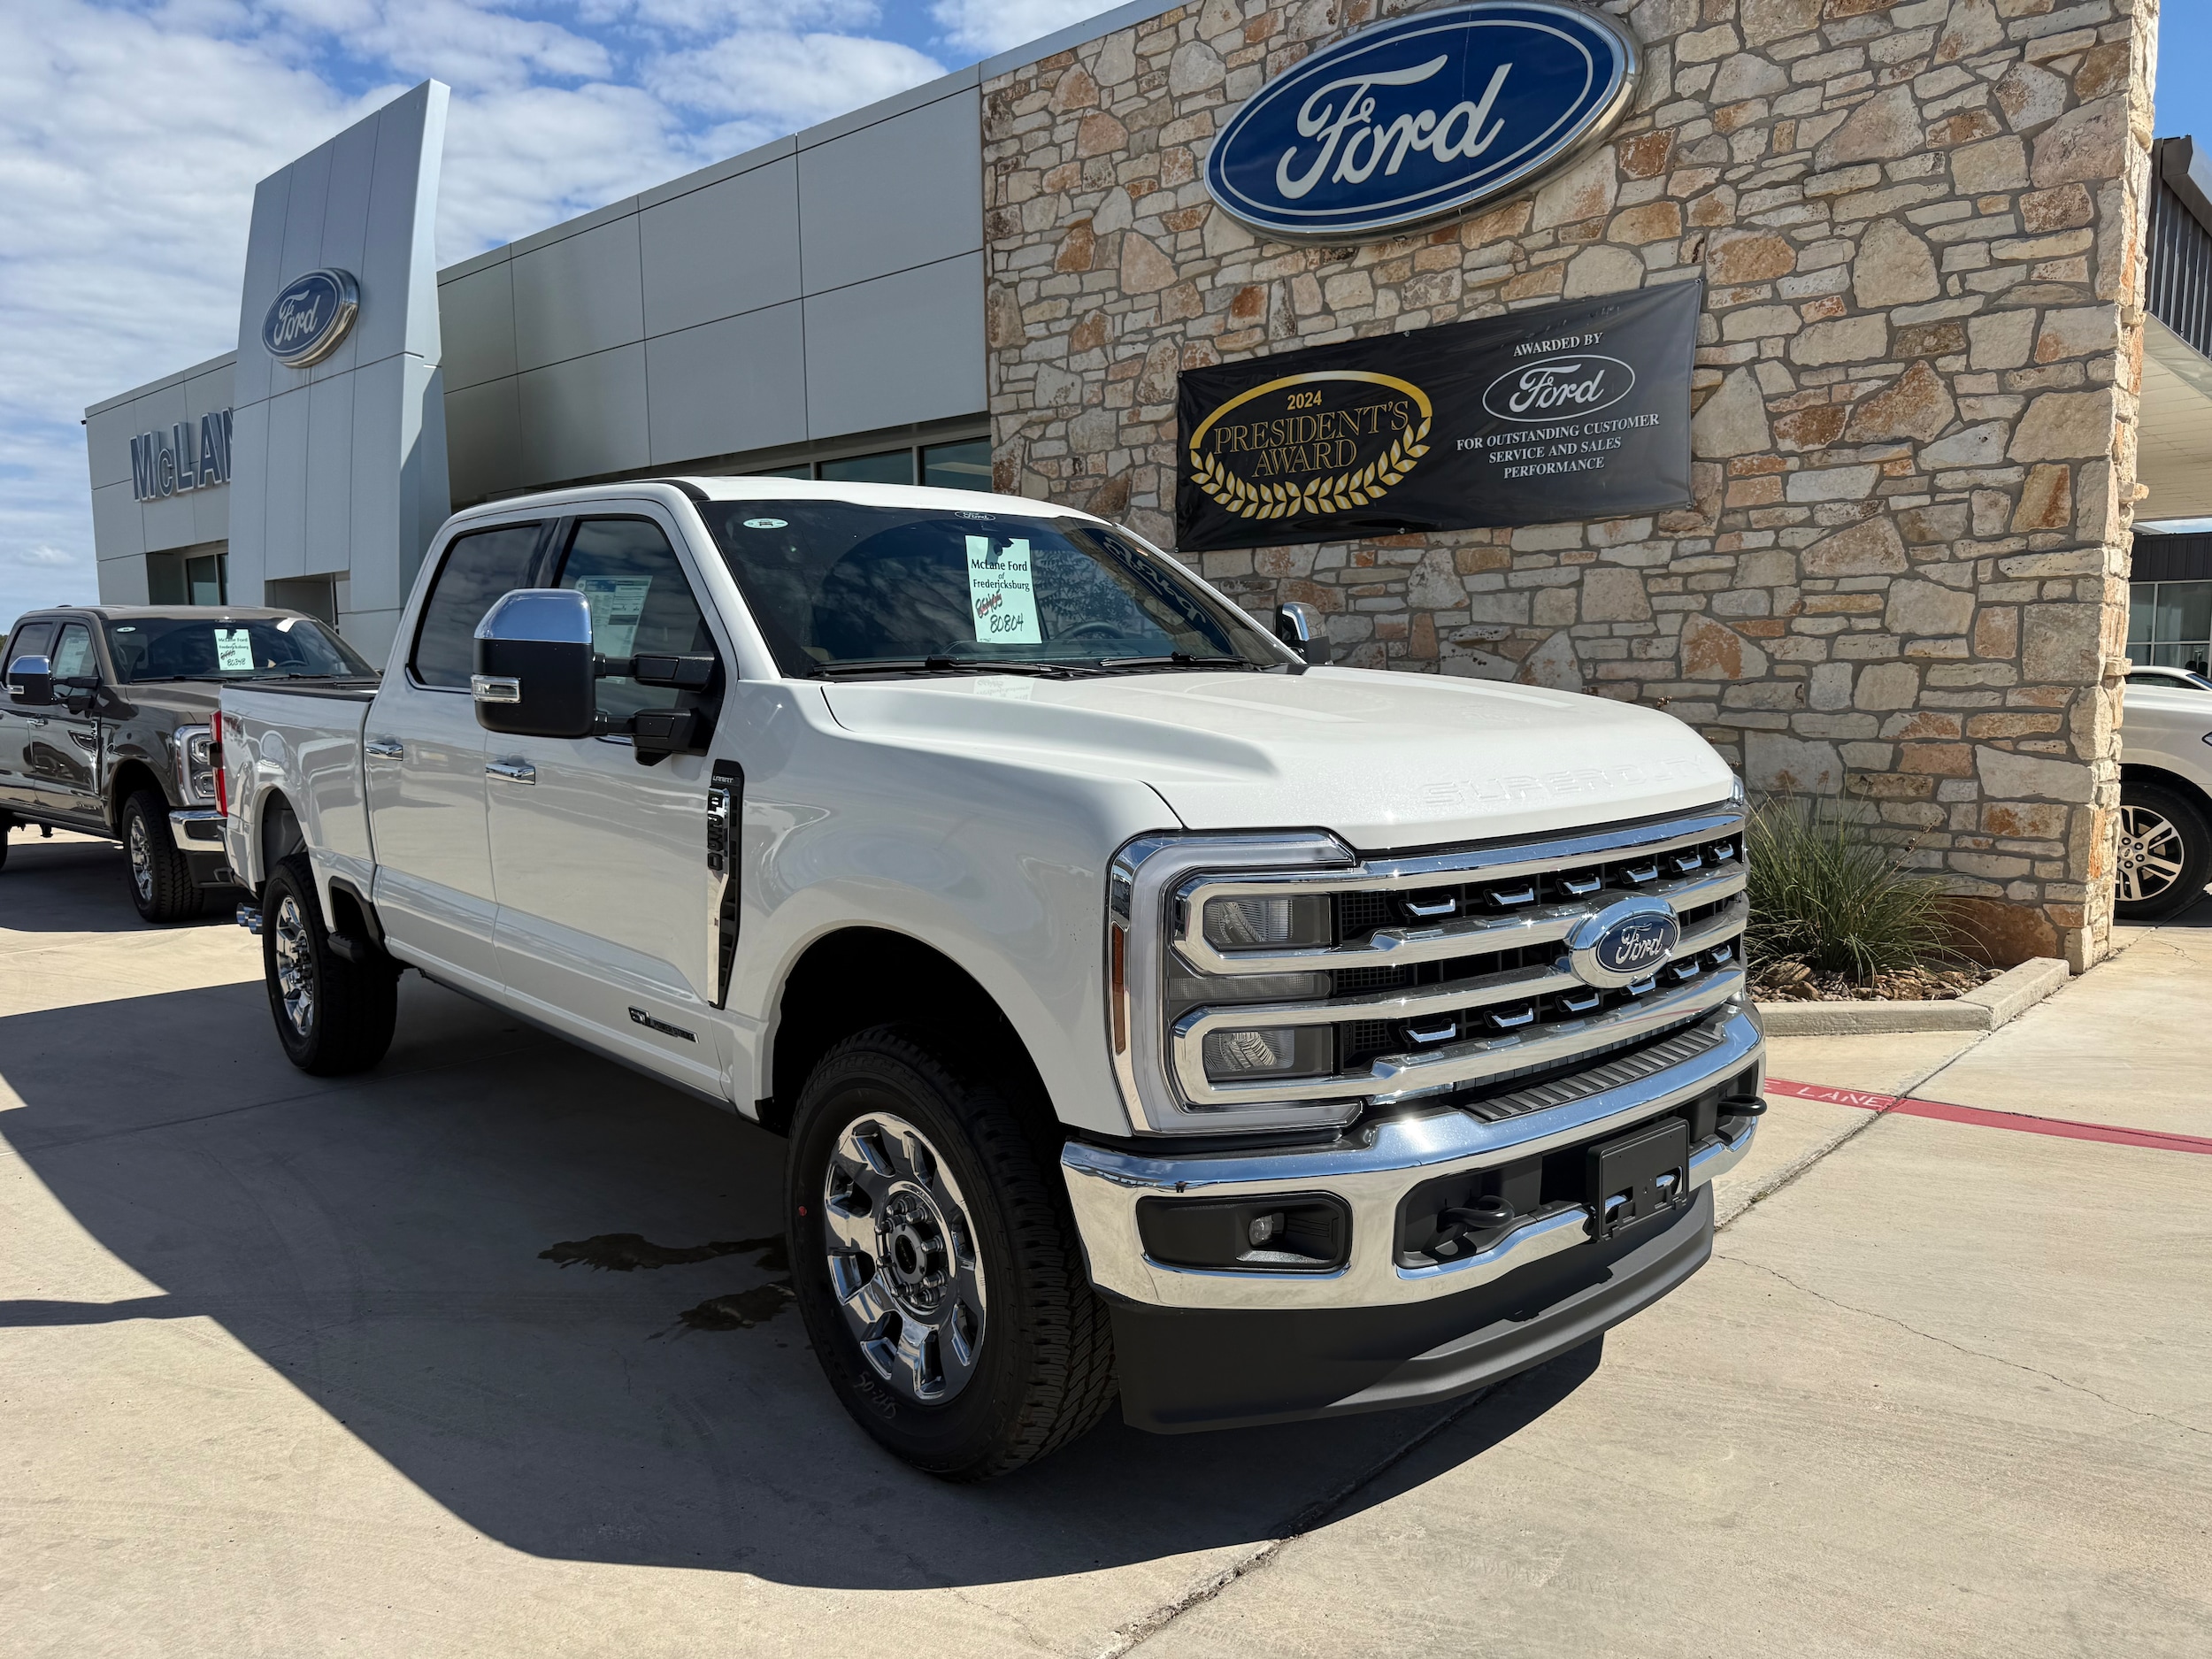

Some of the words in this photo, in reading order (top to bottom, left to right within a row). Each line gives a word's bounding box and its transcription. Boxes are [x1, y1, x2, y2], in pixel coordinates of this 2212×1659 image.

[1276, 54, 1513, 199] Ford
[273, 289, 321, 346] Ford
[1513, 336, 1580, 357] AWARDED
[1584, 333, 1603, 346] BY
[1286, 390, 1323, 411] 2024
[1509, 364, 1605, 413] Ford
[1213, 401, 1409, 455] PRESIDENT'S
[1456, 438, 1484, 451] FOR
[1486, 425, 1580, 448] OUTSTANDING
[1584, 413, 1660, 435] CUSTOMER
[1251, 438, 1357, 478] AWARD
[1488, 446, 1546, 464] SERVICE
[1548, 443, 1578, 457] AND
[1580, 437, 1622, 453] SALES
[1503, 457, 1605, 479] PERFORMANCE
[972, 559, 1006, 571] McLane
[1008, 561, 1027, 572] Ford
[973, 580, 1030, 592] Fredericksburg
[990, 612, 1024, 634] 80804
[1615, 923, 1663, 964] Ford
[1797, 1087, 1884, 1108] LANE
